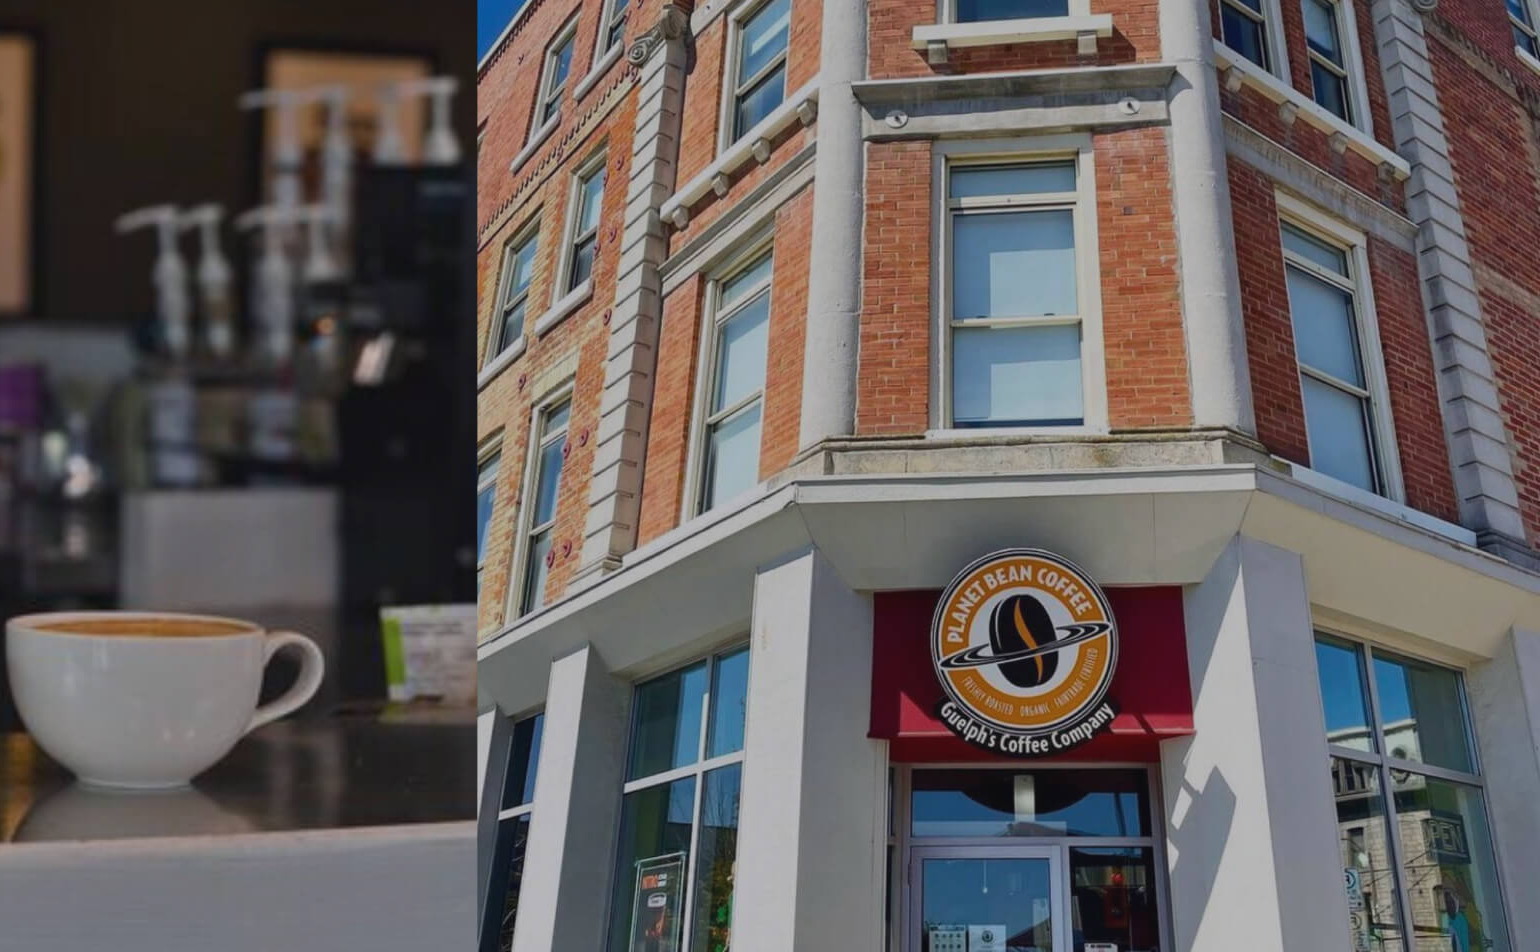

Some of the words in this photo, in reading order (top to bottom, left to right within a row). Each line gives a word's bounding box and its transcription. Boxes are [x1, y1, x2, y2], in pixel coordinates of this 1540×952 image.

[947, 580, 986, 643] PLANET
[982, 564, 1032, 591] BEAN
[1036, 567, 1092, 616] COFFEE
[962, 675, 986, 702] FRESHLY
[986, 696, 1014, 716] ROASTED
[1020, 705, 1051, 717] ORGANIC
[941, 701, 997, 748] Guelph's
[1000, 734, 1050, 754] Coffee
[1051, 702, 1116, 748] Company
